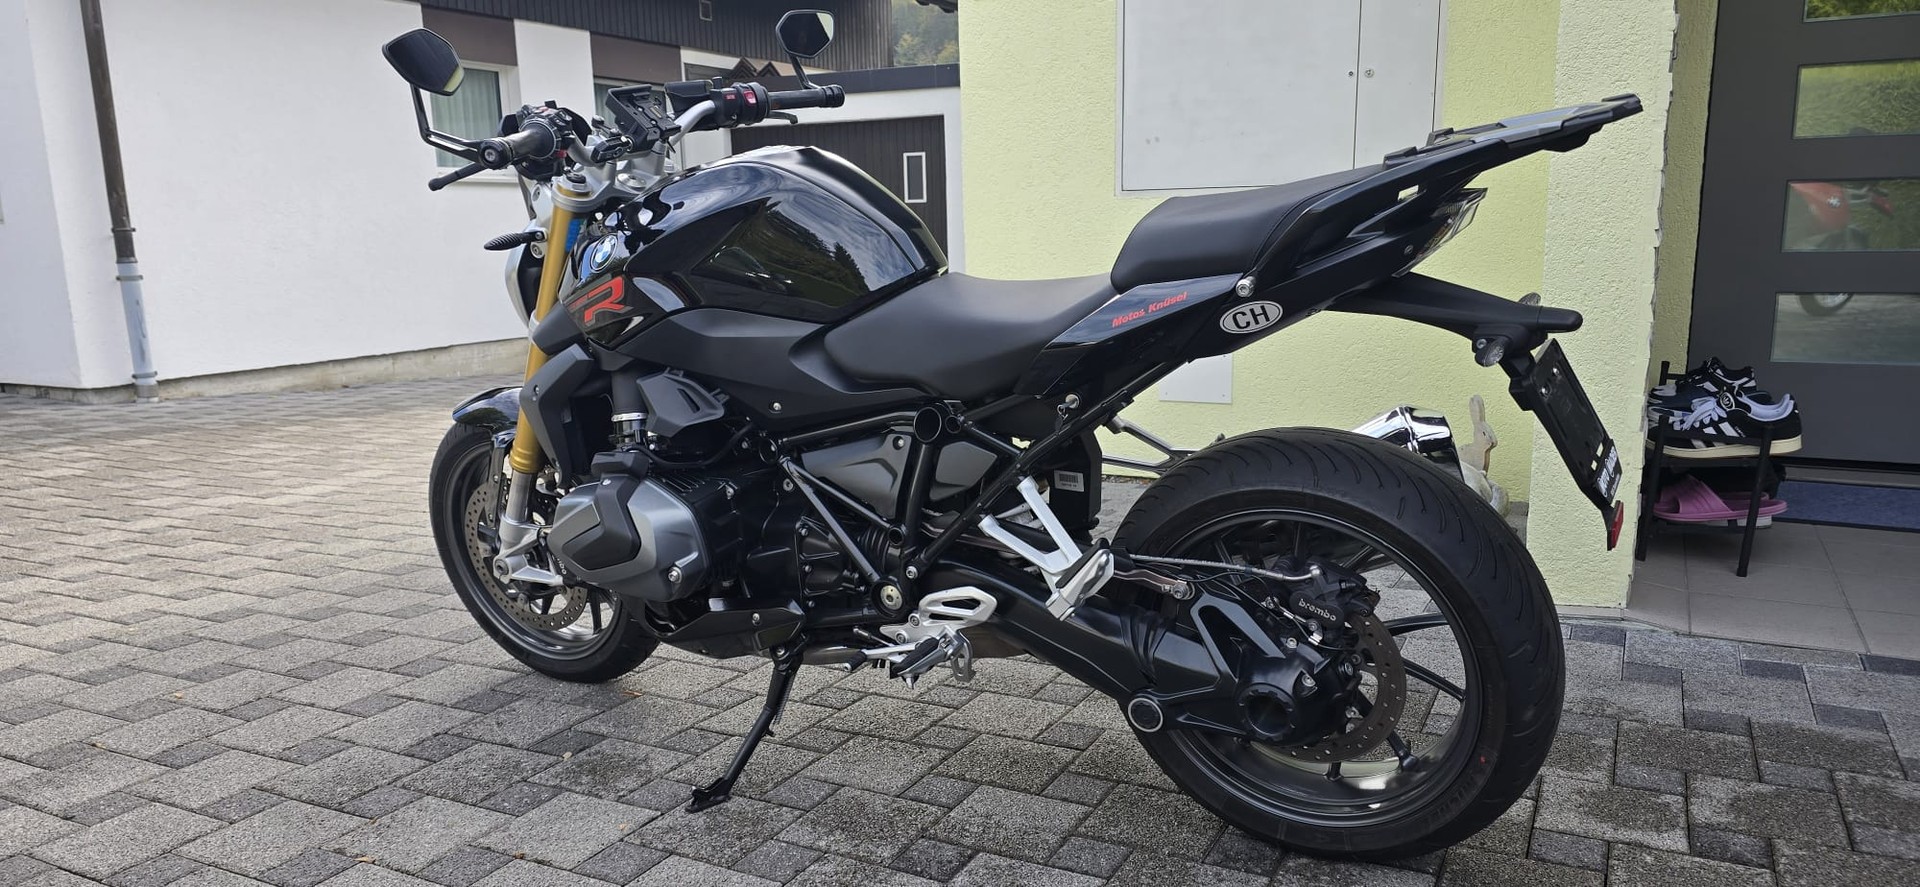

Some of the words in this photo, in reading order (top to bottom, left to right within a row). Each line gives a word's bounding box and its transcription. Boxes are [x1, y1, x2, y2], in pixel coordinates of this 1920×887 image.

[1111, 308, 1145, 328] Motos
[1148, 291, 1188, 313] Knüsel
[1233, 305, 1270, 330] CH
[1298, 598, 1337, 621] brembo
